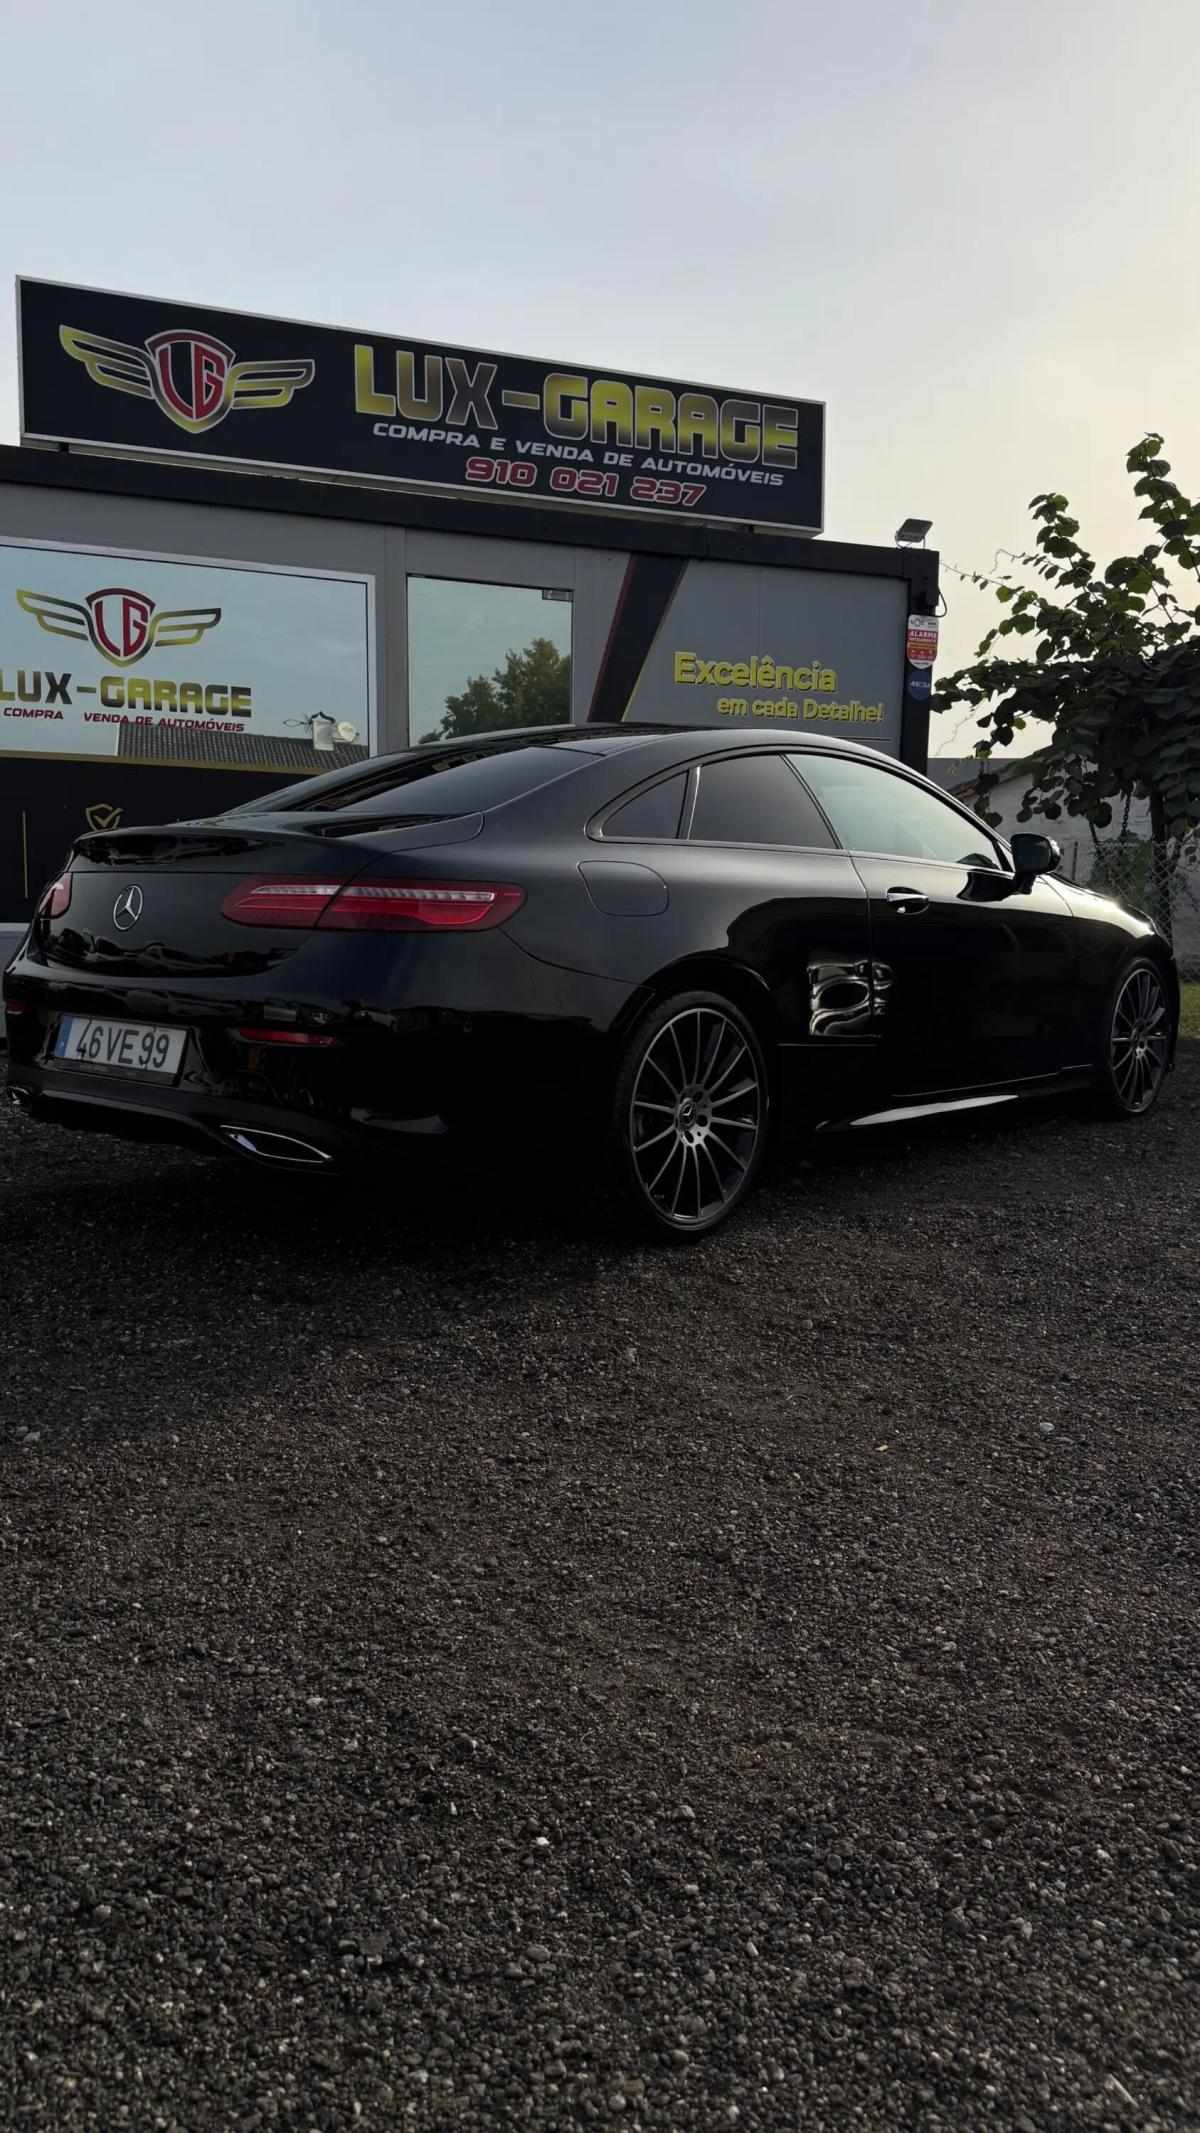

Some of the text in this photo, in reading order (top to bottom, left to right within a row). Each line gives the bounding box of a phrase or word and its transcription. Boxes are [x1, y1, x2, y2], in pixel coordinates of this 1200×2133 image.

[353, 343, 798, 469] LUX-GARAGE
[373, 422, 785, 487] COMPRA E VENDA DE AUTOMÓVEIS
[465, 456, 707, 507] 910 021 237
[673, 651, 837, 693] Excelência
[3, 707, 245, 732] COMPRA VENDA DE AUTOMÓVEIS
[717, 697, 884, 724] em cada Detalhe!
